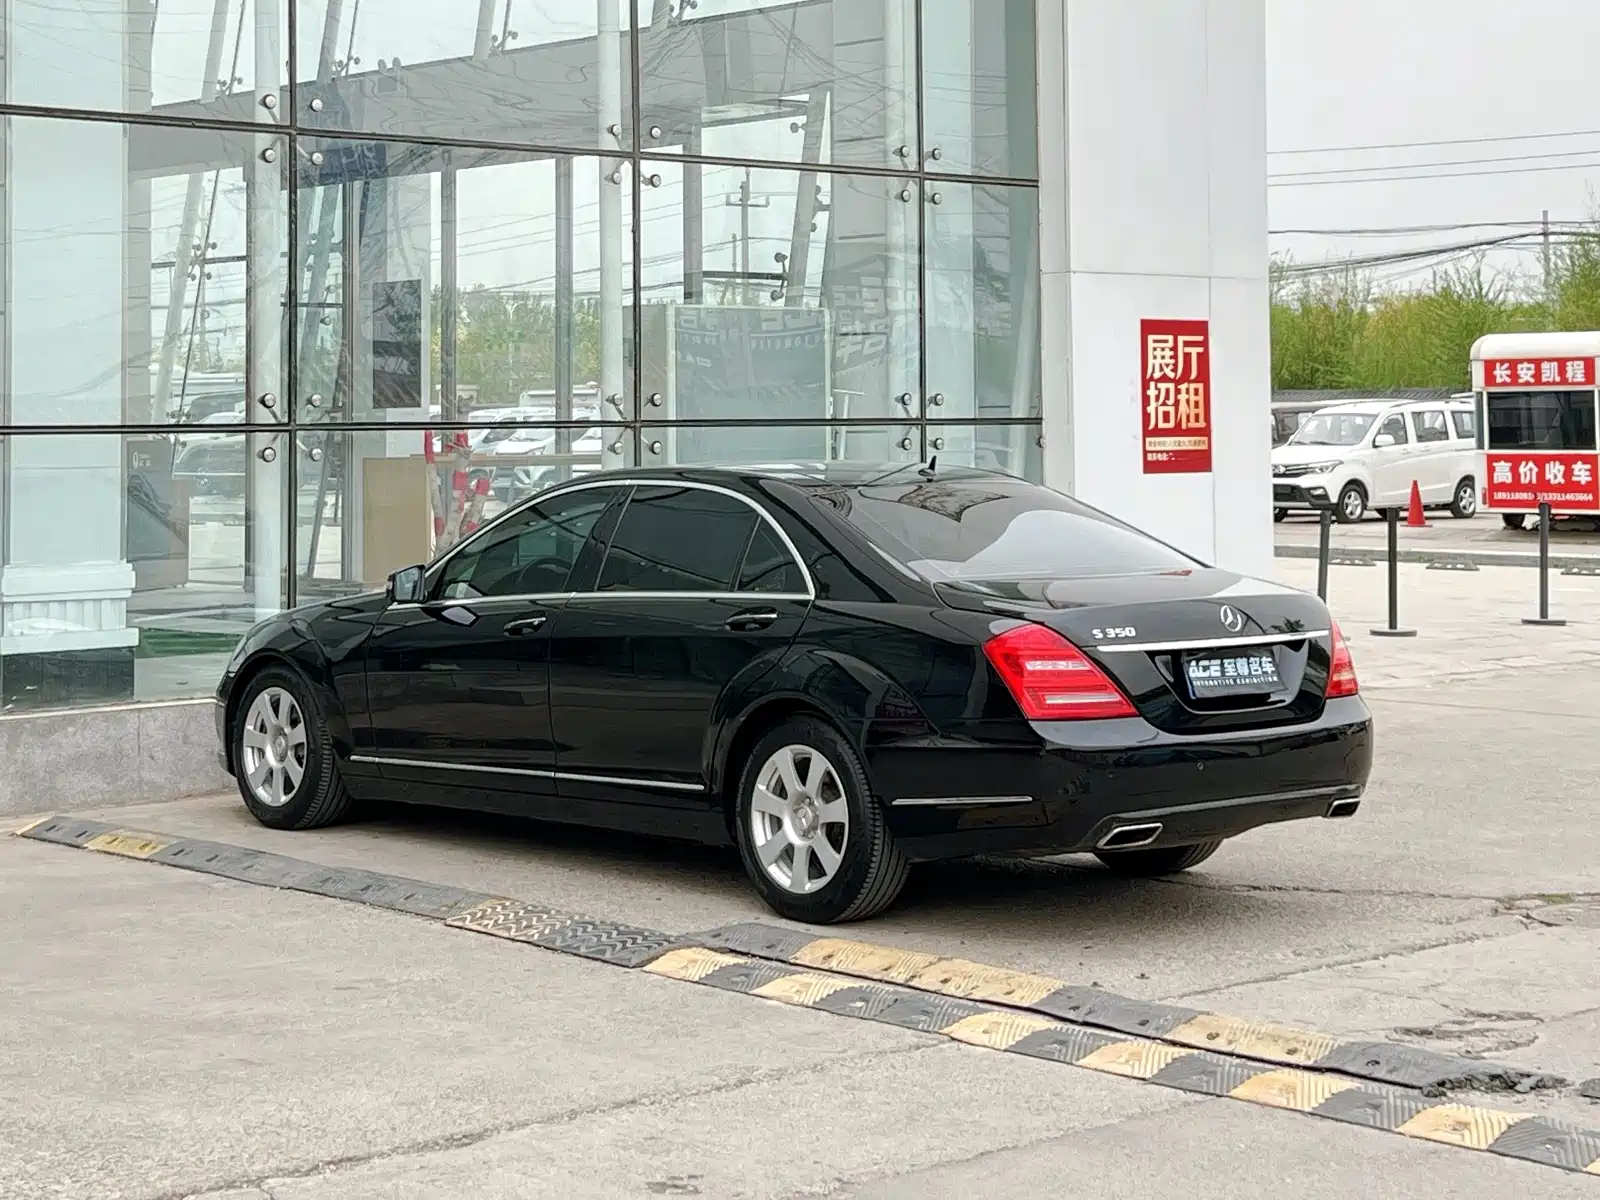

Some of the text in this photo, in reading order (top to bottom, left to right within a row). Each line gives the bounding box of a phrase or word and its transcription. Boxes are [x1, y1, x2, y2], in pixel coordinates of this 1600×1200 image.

[1146, 334, 1204, 380] 展厅
[1493, 360, 1586, 383] 长安凯程
[1146, 381, 1207, 430] 招租
[1492, 460, 1593, 485] 高价收车
[1091, 626, 1136, 639] S 350
[1188, 656, 1276, 678] ACE 至尊名车
